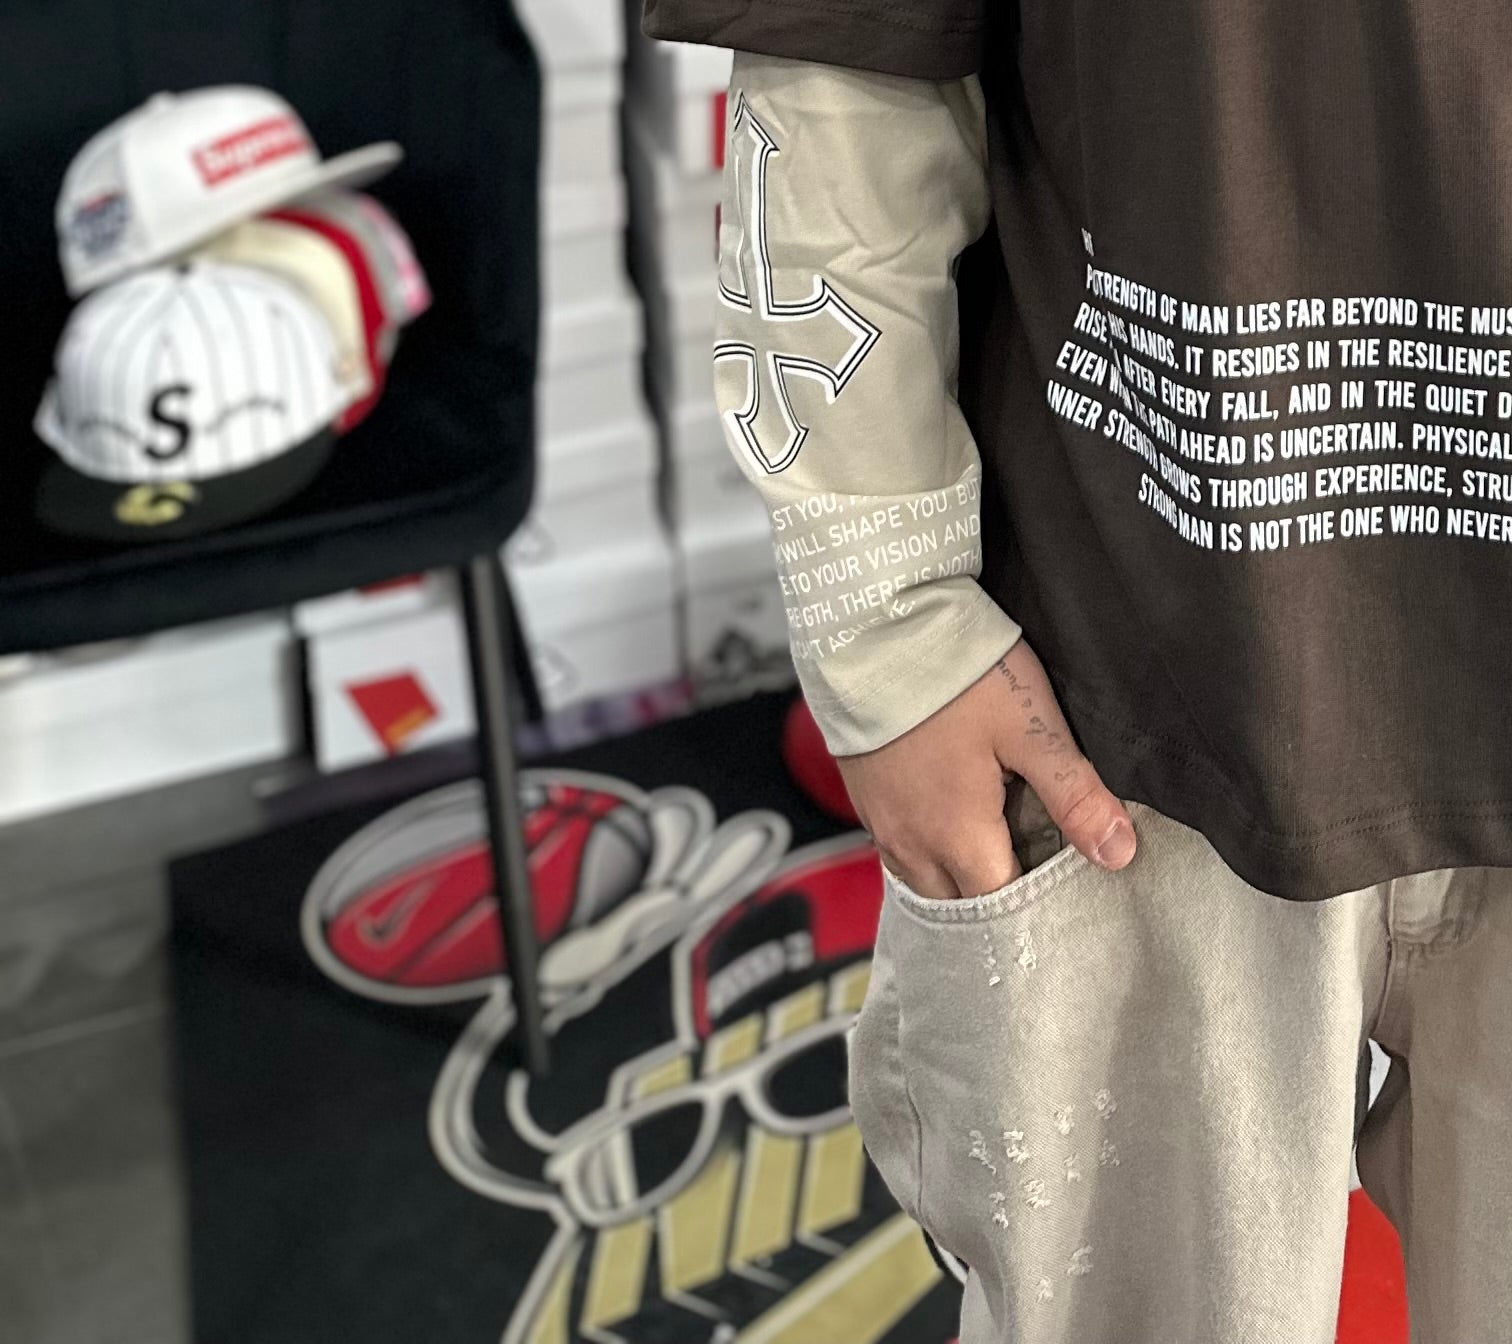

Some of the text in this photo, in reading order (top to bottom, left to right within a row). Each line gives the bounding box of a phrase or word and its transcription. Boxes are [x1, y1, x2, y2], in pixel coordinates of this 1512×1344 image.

[1129, 322, 1180, 370] HANDS.
[1185, 345, 1204, 376] IT
[1212, 342, 1300, 378] RESIDES
[1307, 340, 1330, 369] IN
[1338, 338, 1381, 368] THE
[1388, 338, 1512, 378] RESILIENCE
[1160, 293, 1178, 325] OF
[1181, 301, 1229, 335] MAN
[1236, 301, 1282, 335] LIES
[1286, 298, 1326, 329] FAR
[1332, 296, 1418, 327] BEYOND
[1423, 301, 1465, 333] THE
[1073, 301, 1108, 343] RISE
[1161, 375, 1211, 420] EVERY
[1221, 389, 1279, 422] FALL,
[1288, 382, 1331, 416] AND
[1341, 380, 1364, 409] IN
[1374, 379, 1416, 409] THE
[1425, 383, 1488, 417] QUIET
[143, 384, 193, 462] S
[1056, 340, 1108, 386] EVEN
[1148, 407, 1178, 450] PATH
[1179, 428, 1246, 466] AHEAD
[1253, 432, 1275, 464] IS
[1280, 421, 1404, 460] UNCERTAIN.
[1047, 379, 1103, 430] INNER
[1159, 451, 1203, 505] GROWS
[1208, 471, 1308, 509] THROUGH
[1315, 463, 1453, 498] EXPERIENCE,
[795, 493, 843, 522] YOU,
[829, 505, 904, 548] SHAPE
[956, 478, 980, 506] BUT
[1139, 472, 1177, 529] STRONG
[1178, 508, 1213, 550] MAN
[1220, 522, 1243, 552] IS
[1249, 517, 1293, 552] NOT
[1296, 510, 1335, 546] THE
[1340, 506, 1384, 538] ONE
[1389, 505, 1440, 534] WHO
[789, 572, 811, 597] TO
[812, 555, 863, 589] YOUR
[865, 530, 938, 571] VISION
[943, 514, 981, 547] AND
[838, 574, 907, 616] THERE
